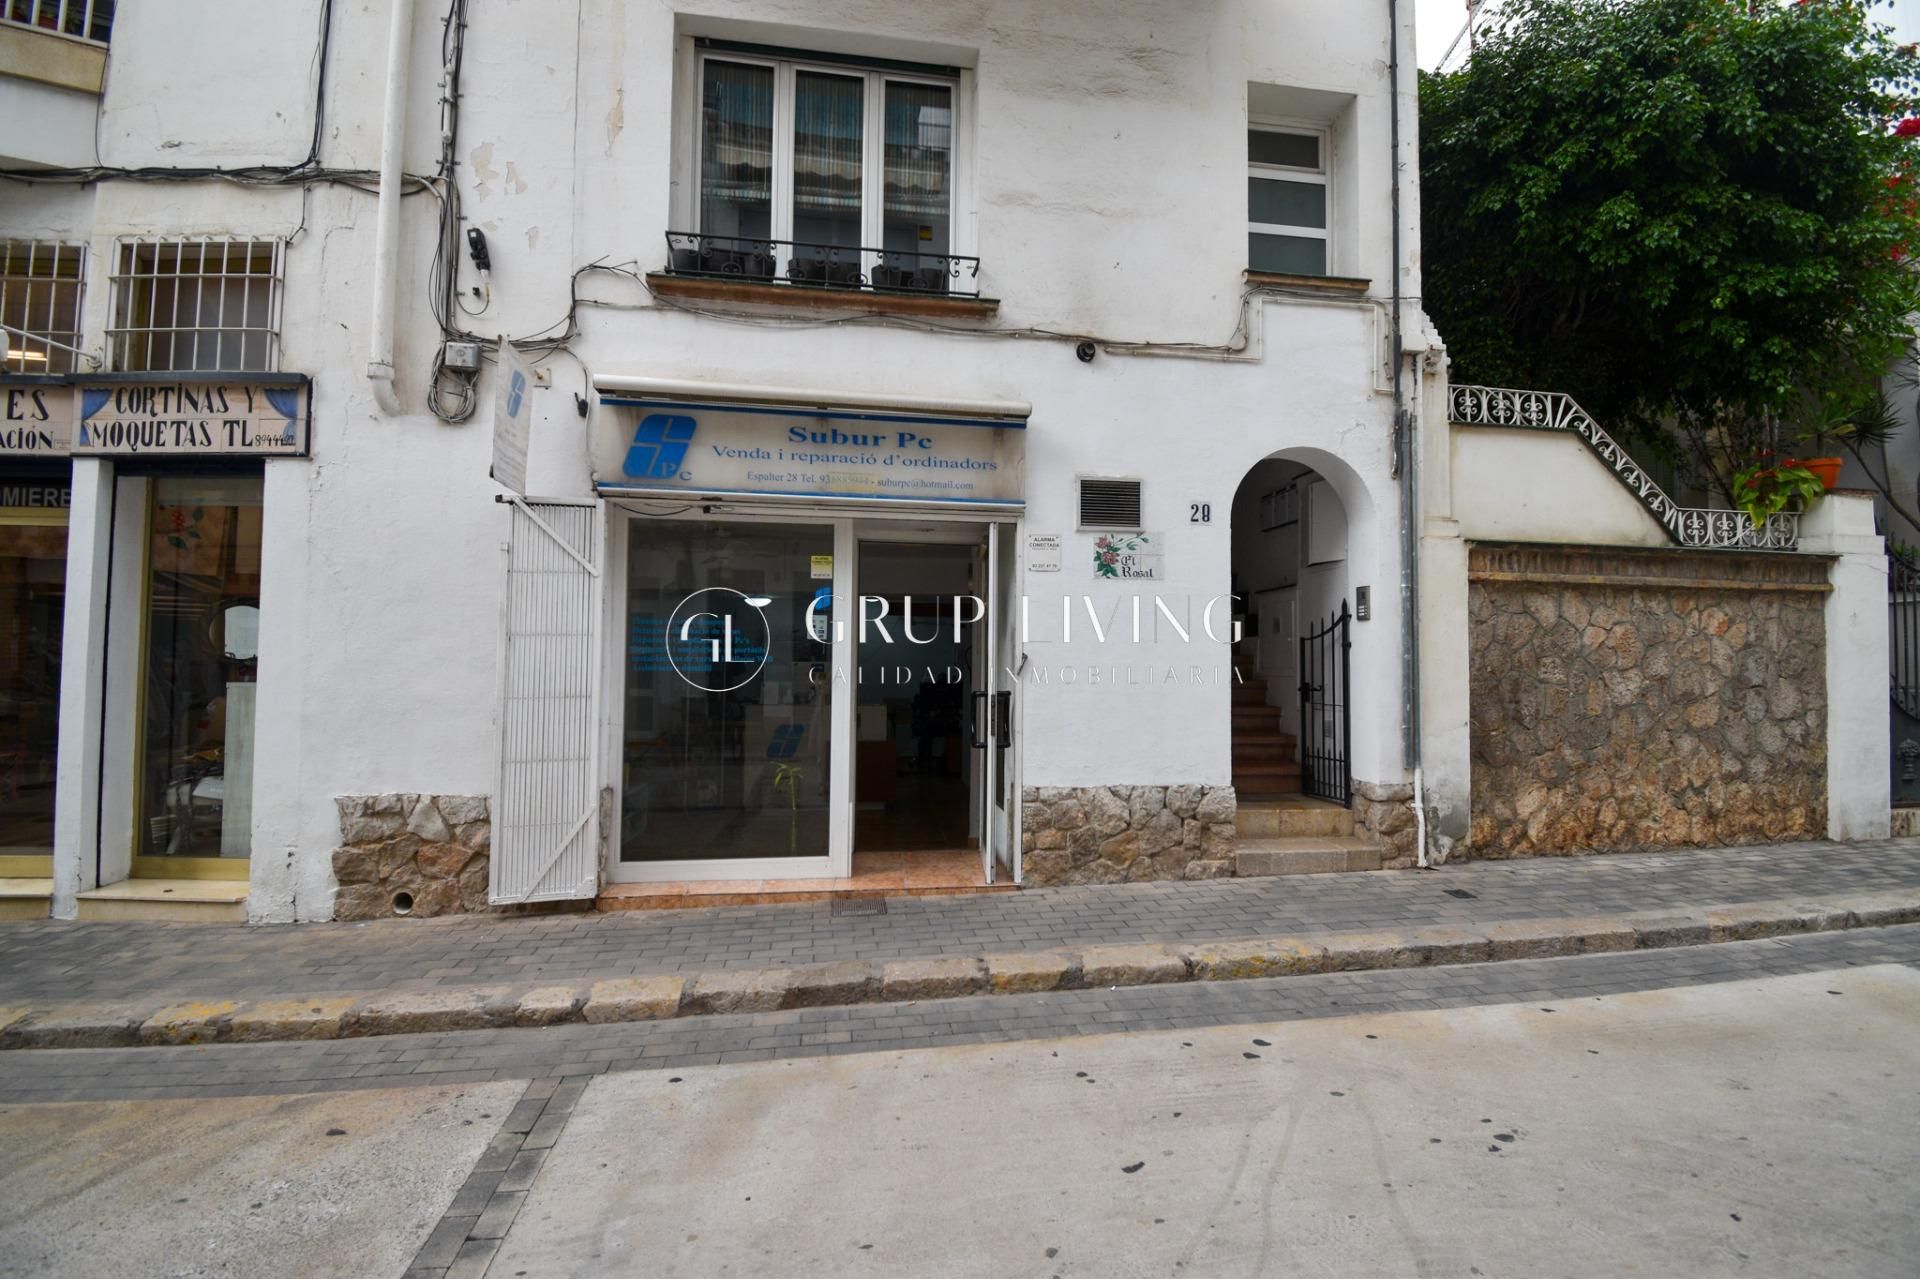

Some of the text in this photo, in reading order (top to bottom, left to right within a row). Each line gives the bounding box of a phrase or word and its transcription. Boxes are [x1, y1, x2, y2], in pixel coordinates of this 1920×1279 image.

[7, 389, 49, 421] ES
[115, 383, 258, 417] CORTINAS Y
[93, 420, 212, 451] MOQUETAS
[223, 420, 252, 446] TL
[788, 425, 932, 449] Subur Pc
[713, 445, 770, 460] Venda
[791, 451, 877, 465] reparació
[883, 454, 998, 471] d'ordinadors
[787, 473, 798, 482] 28
[1190, 504, 1210, 522] 28
[1122, 566, 1154, 578] Rosal
